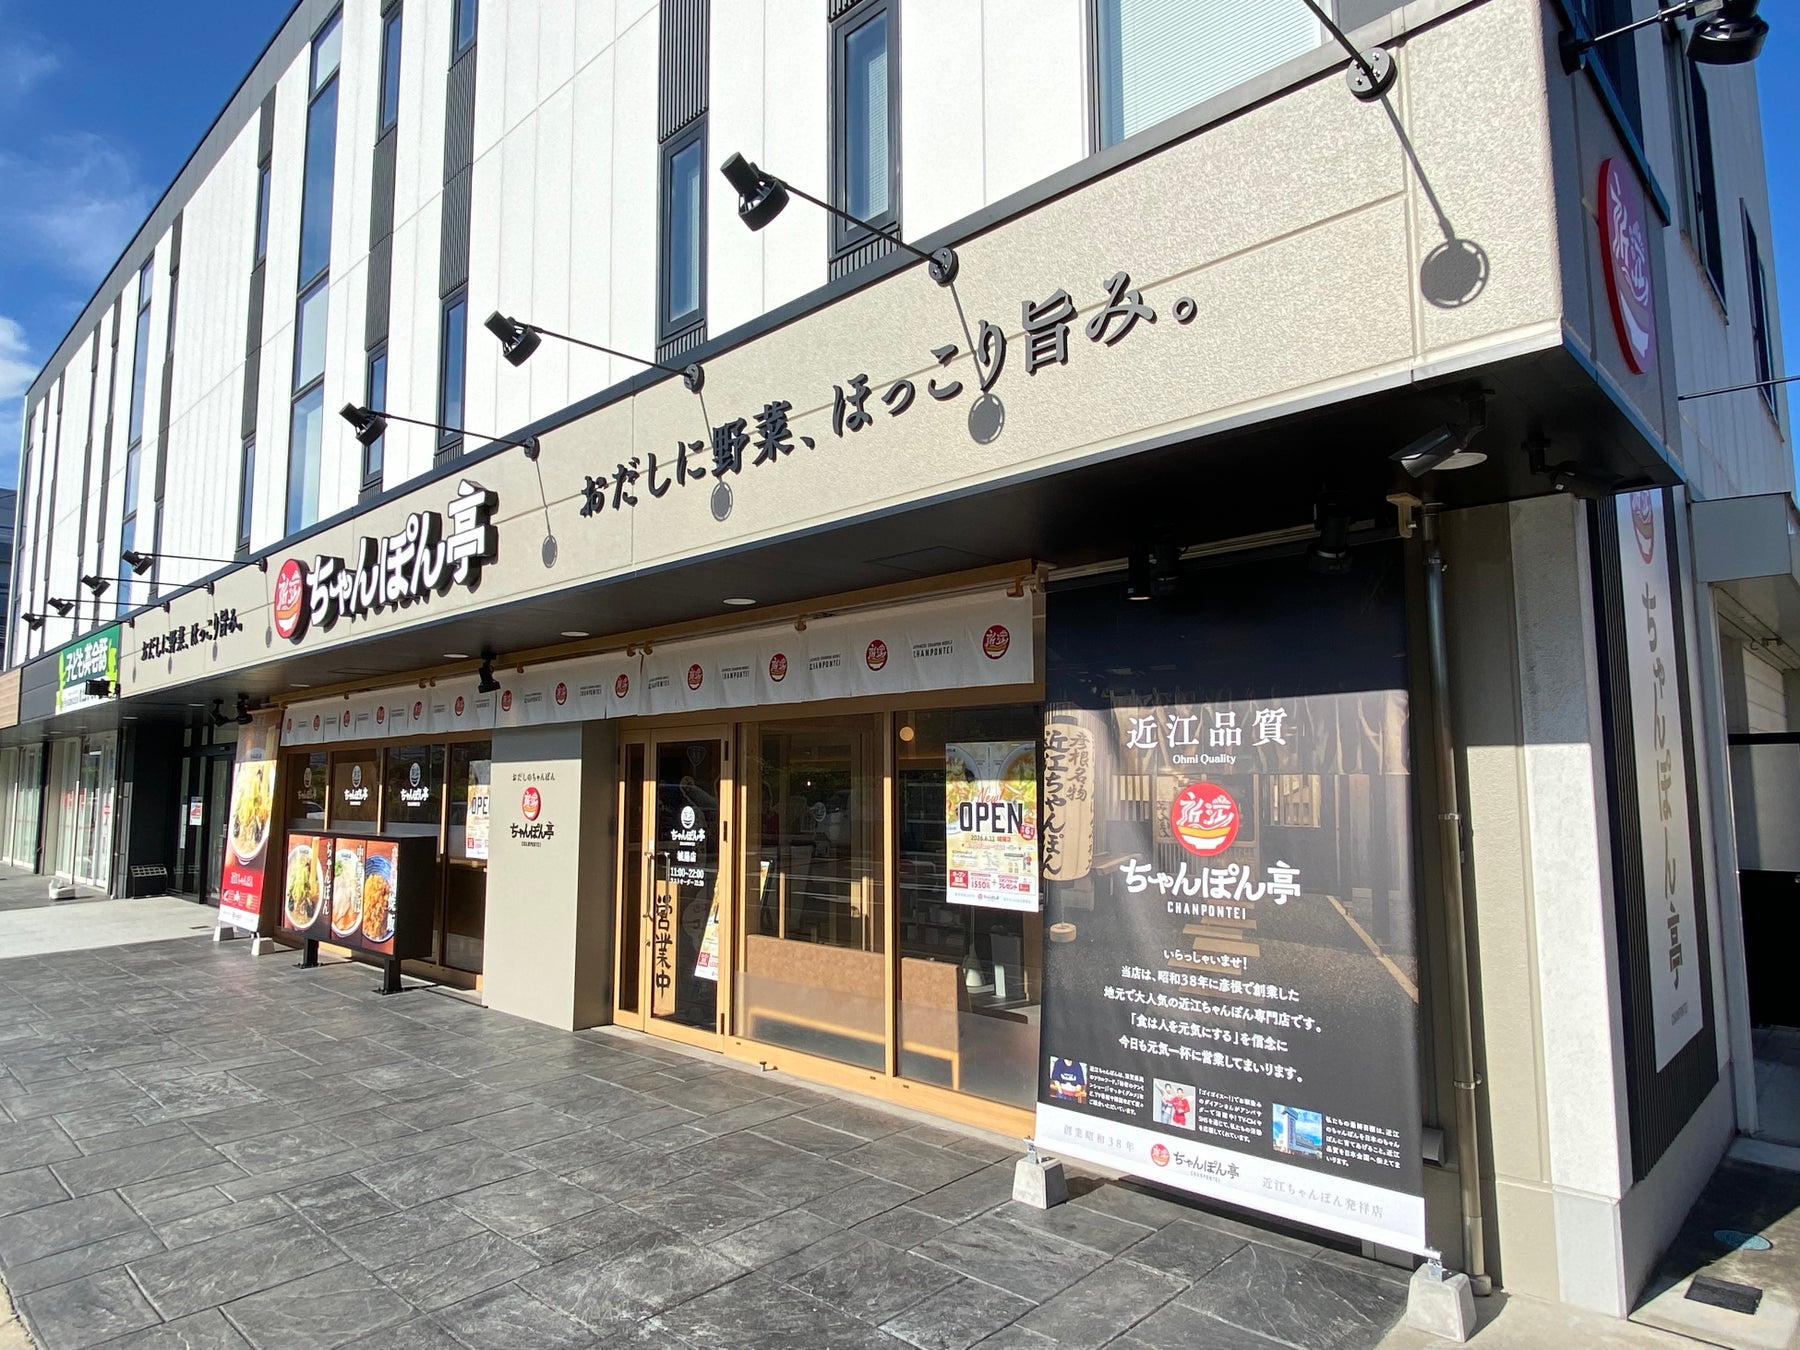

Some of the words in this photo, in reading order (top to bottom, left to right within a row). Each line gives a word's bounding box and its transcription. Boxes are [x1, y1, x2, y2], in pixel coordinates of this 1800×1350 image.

[580, 270, 1198, 520] おだしに野菜、ほっこり旨み。
[307, 479, 498, 627] ちゃんぽん亭
[66, 637, 108, 682] 子ども英会話
[1126, 707, 1288, 749] 近江品質
[1200, 753, 1237, 766] Quality
[1641, 582, 1683, 990] ちゃんぽん亭
[510, 821, 554, 840] ちゃんぽん亭
[959, 802, 1023, 833] OPEN
[322, 841, 333, 915] ちゃんぽん
[1119, 858, 1301, 905] ちゃんぽん亭
[1167, 901, 1246, 920] CHANPONTEI
[1121, 965, 1300, 1002] 当店は、昭和38年に彦根で創業した
[1103, 986, 1322, 1033] 地元で大人気の近江ちゃんぽん専門店です。
[1131, 1012, 1289, 1053] 「食は人を元気にする」を信念に
[1118, 1035, 1304, 1083] 今日も元気一杯に営業してまいります。
[1173, 1151, 1240, 1179] ちゃんぽん亭
[1261, 1176, 1384, 1218] 近江ちゃんぽん発祥店
